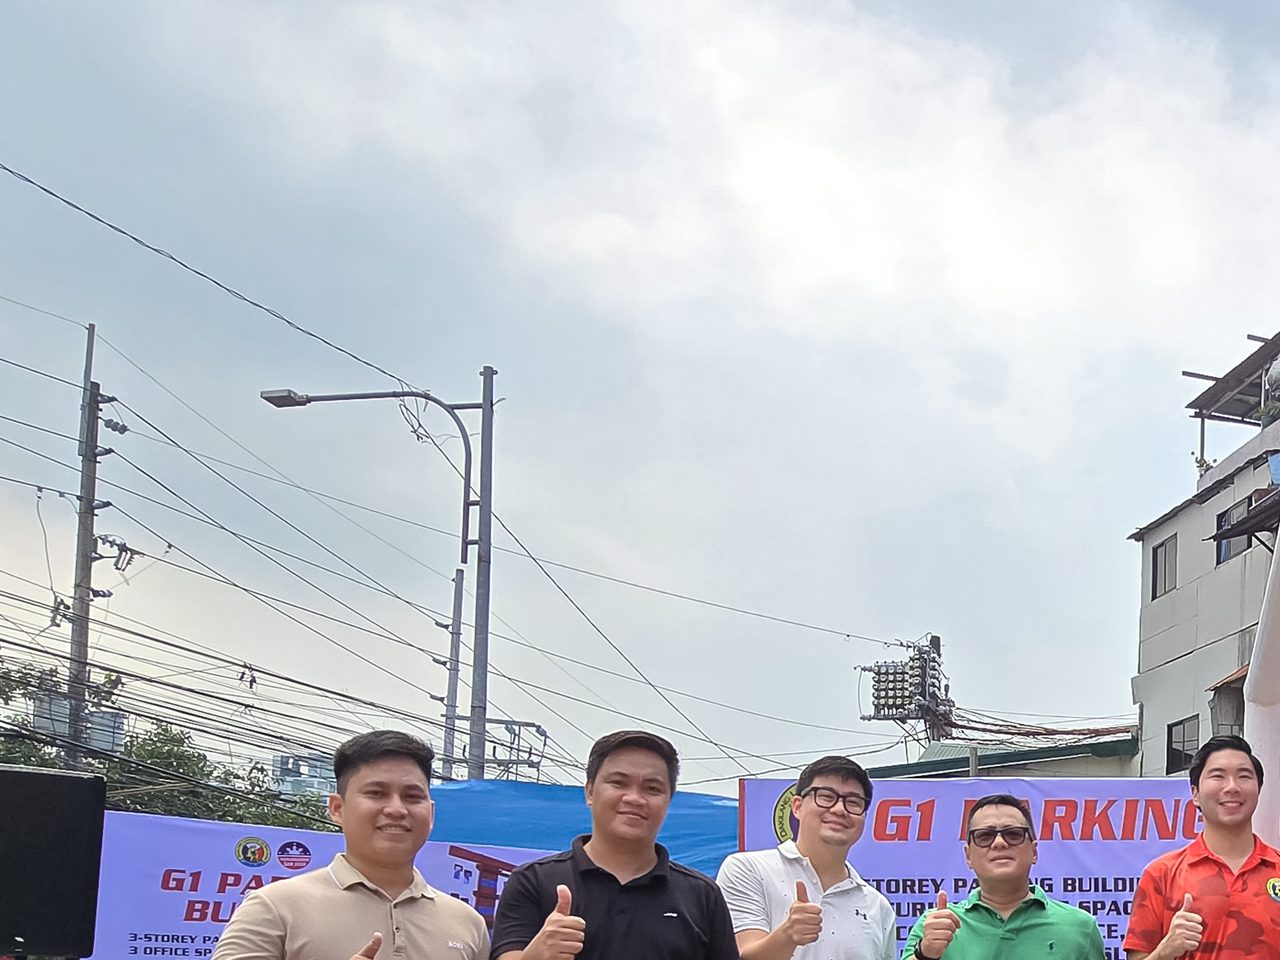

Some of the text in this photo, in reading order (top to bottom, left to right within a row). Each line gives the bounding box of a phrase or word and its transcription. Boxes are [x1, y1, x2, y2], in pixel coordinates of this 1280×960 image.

[873, 798, 937, 842] G1
[958, 799, 1205, 841] RKIN
[161, 868, 202, 892] G1
[865, 878, 945, 895] TOREY
[1063, 877, 1141, 893] BUILDI
[184, 899, 238, 923] BU
[128, 932, 198, 944] 3-STOREY
[128, 945, 138, 955] 3
[143, 946, 190, 957] OFFICE
